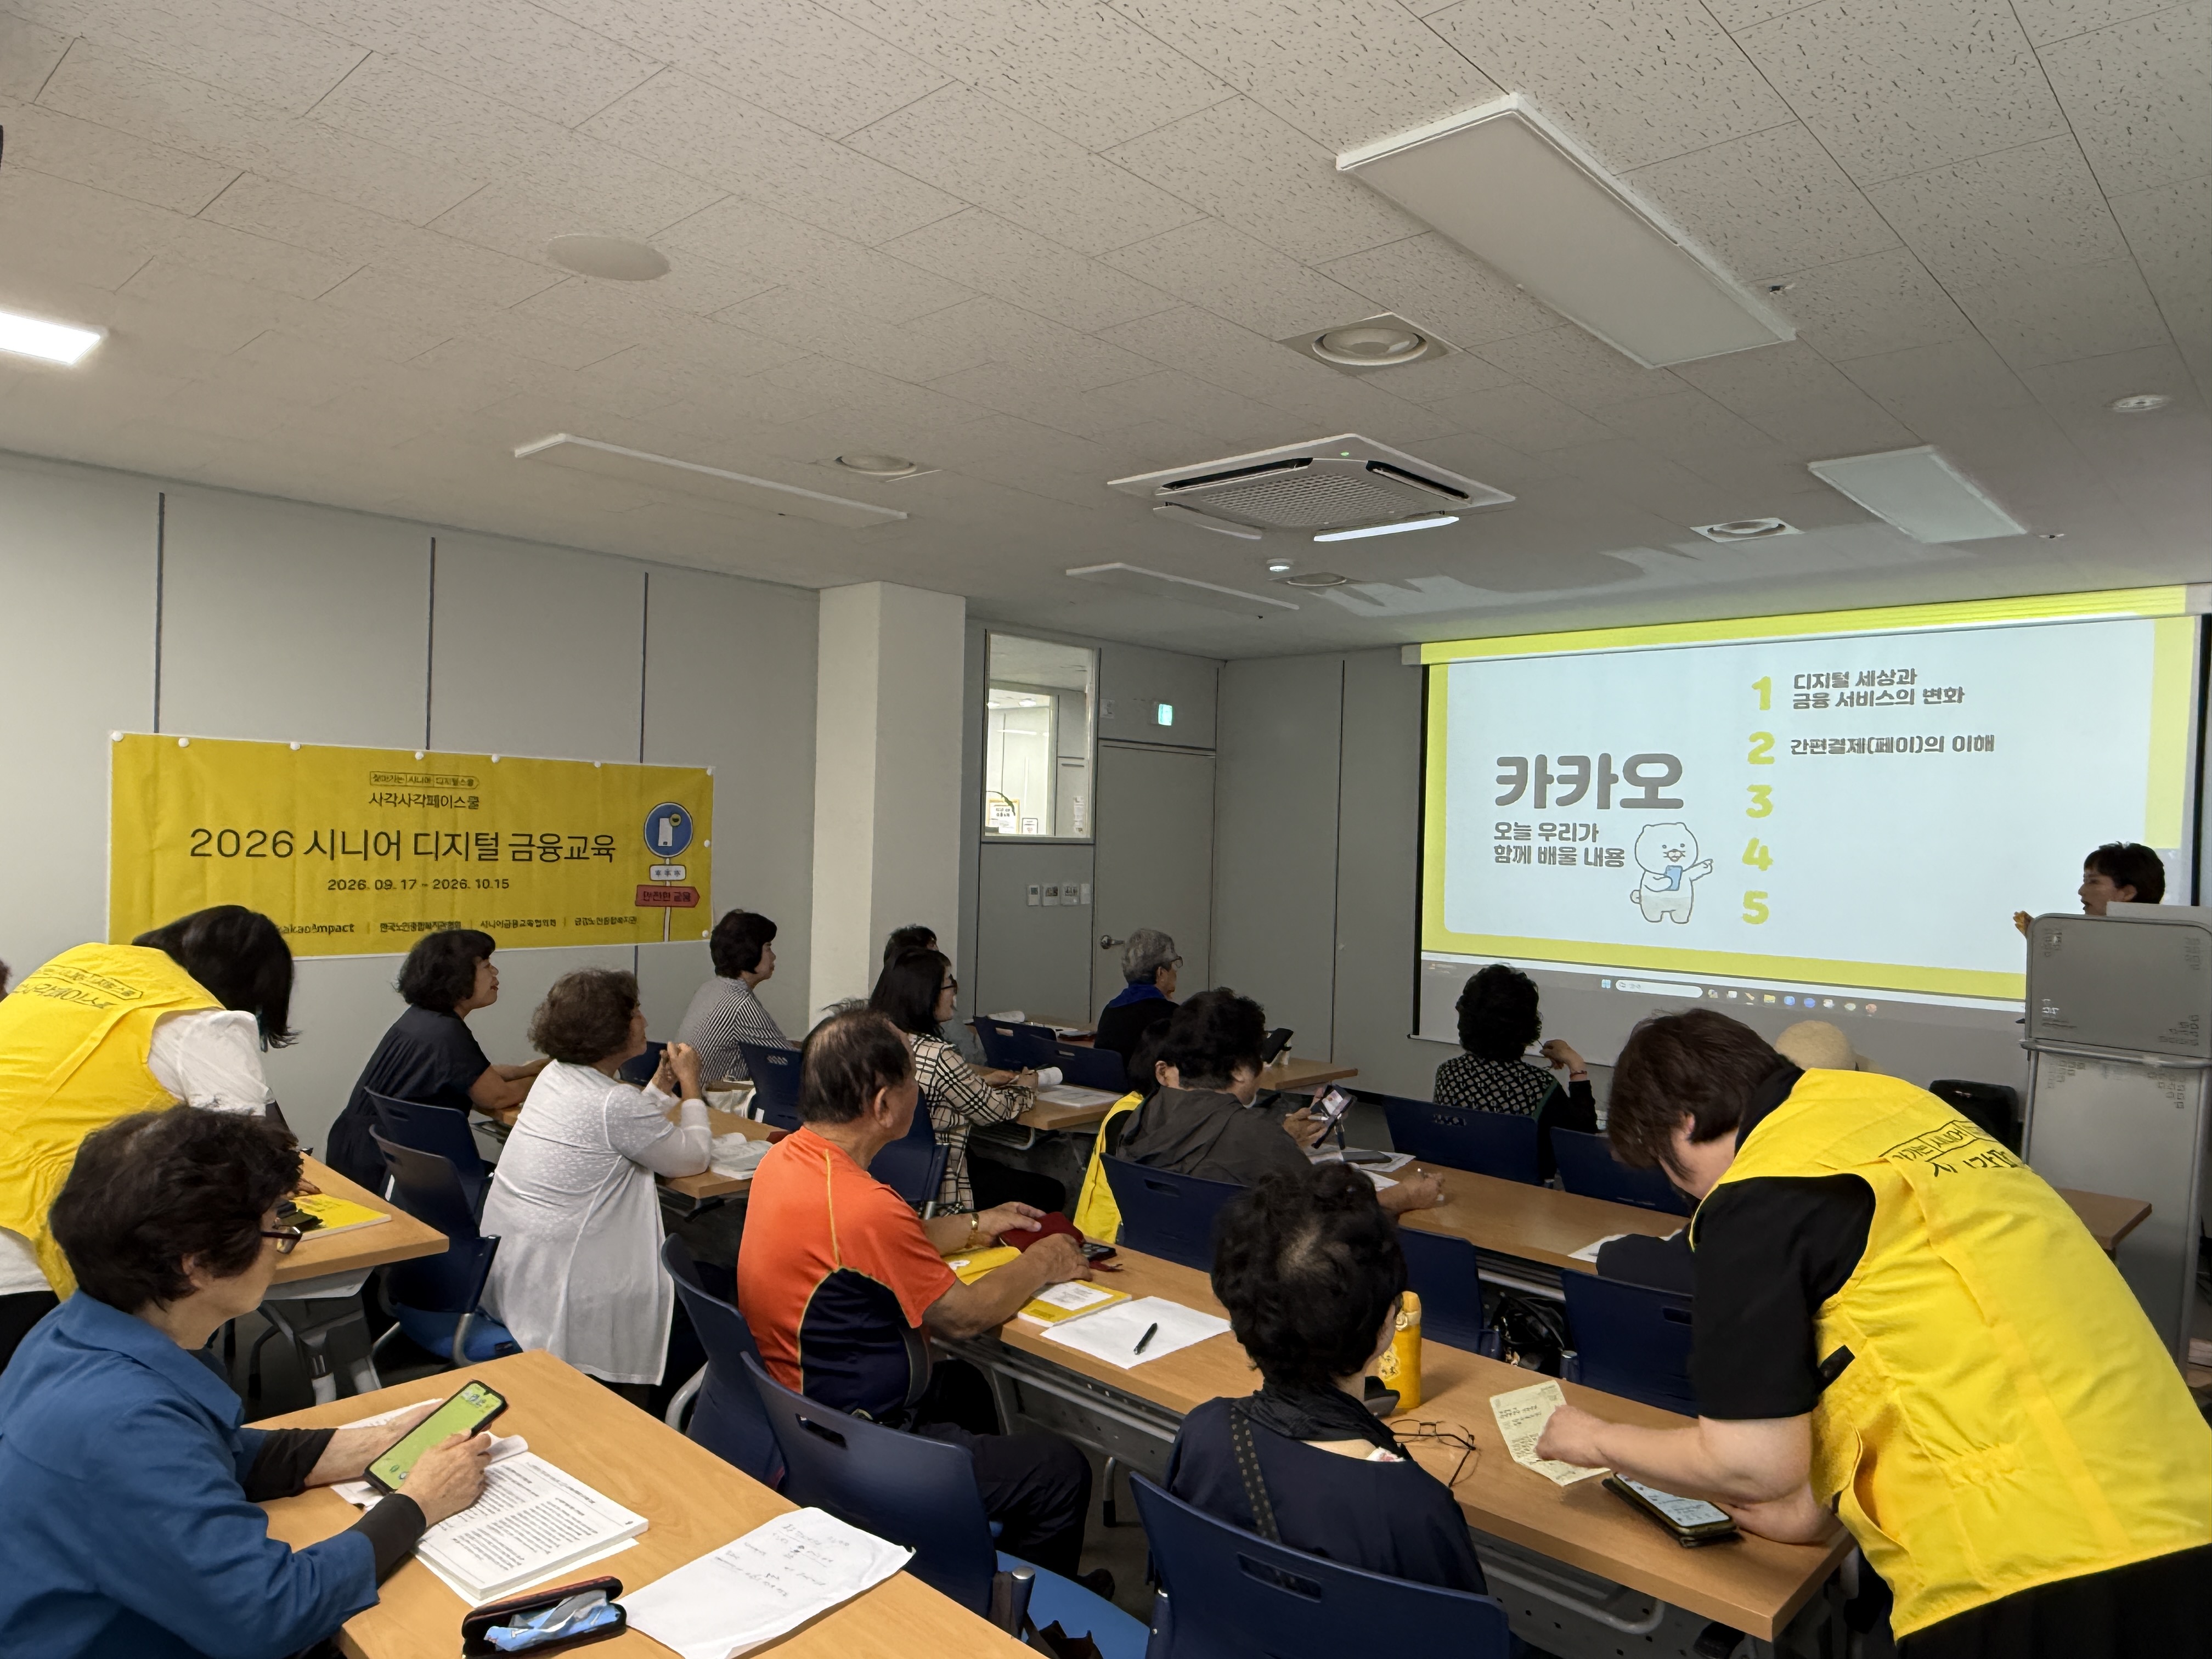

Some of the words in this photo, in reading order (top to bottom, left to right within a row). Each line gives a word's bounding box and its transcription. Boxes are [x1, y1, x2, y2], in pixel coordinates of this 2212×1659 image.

[1751, 676, 1771, 710] 1
[1792, 672, 1849, 689] 디지털
[1855, 668, 1917, 687] 세상과
[1792, 692, 1830, 709] 금융
[1835, 689, 1915, 708] 서비스의
[1922, 686, 1965, 704] 변화
[1747, 731, 1775, 765] 2
[1790, 736, 1945, 755] 간편결제(페이)의
[1952, 735, 1995, 753] 이해
[1495, 753, 1684, 810] 카카오
[1746, 785, 1774, 818] 3
[190, 828, 295, 858] 2026
[303, 829, 400, 861] 시니어
[414, 830, 499, 861] 디지털
[508, 832, 616, 863] 금융교육
[1494, 822, 1532, 841] 오늘
[1538, 823, 1599, 842] 우리가
[1494, 844, 1532, 865] 함께
[1538, 846, 1577, 866] 배울
[1584, 847, 1625, 867] 내용
[1742, 837, 1774, 871] 4
[1741, 890, 1770, 924] 5
